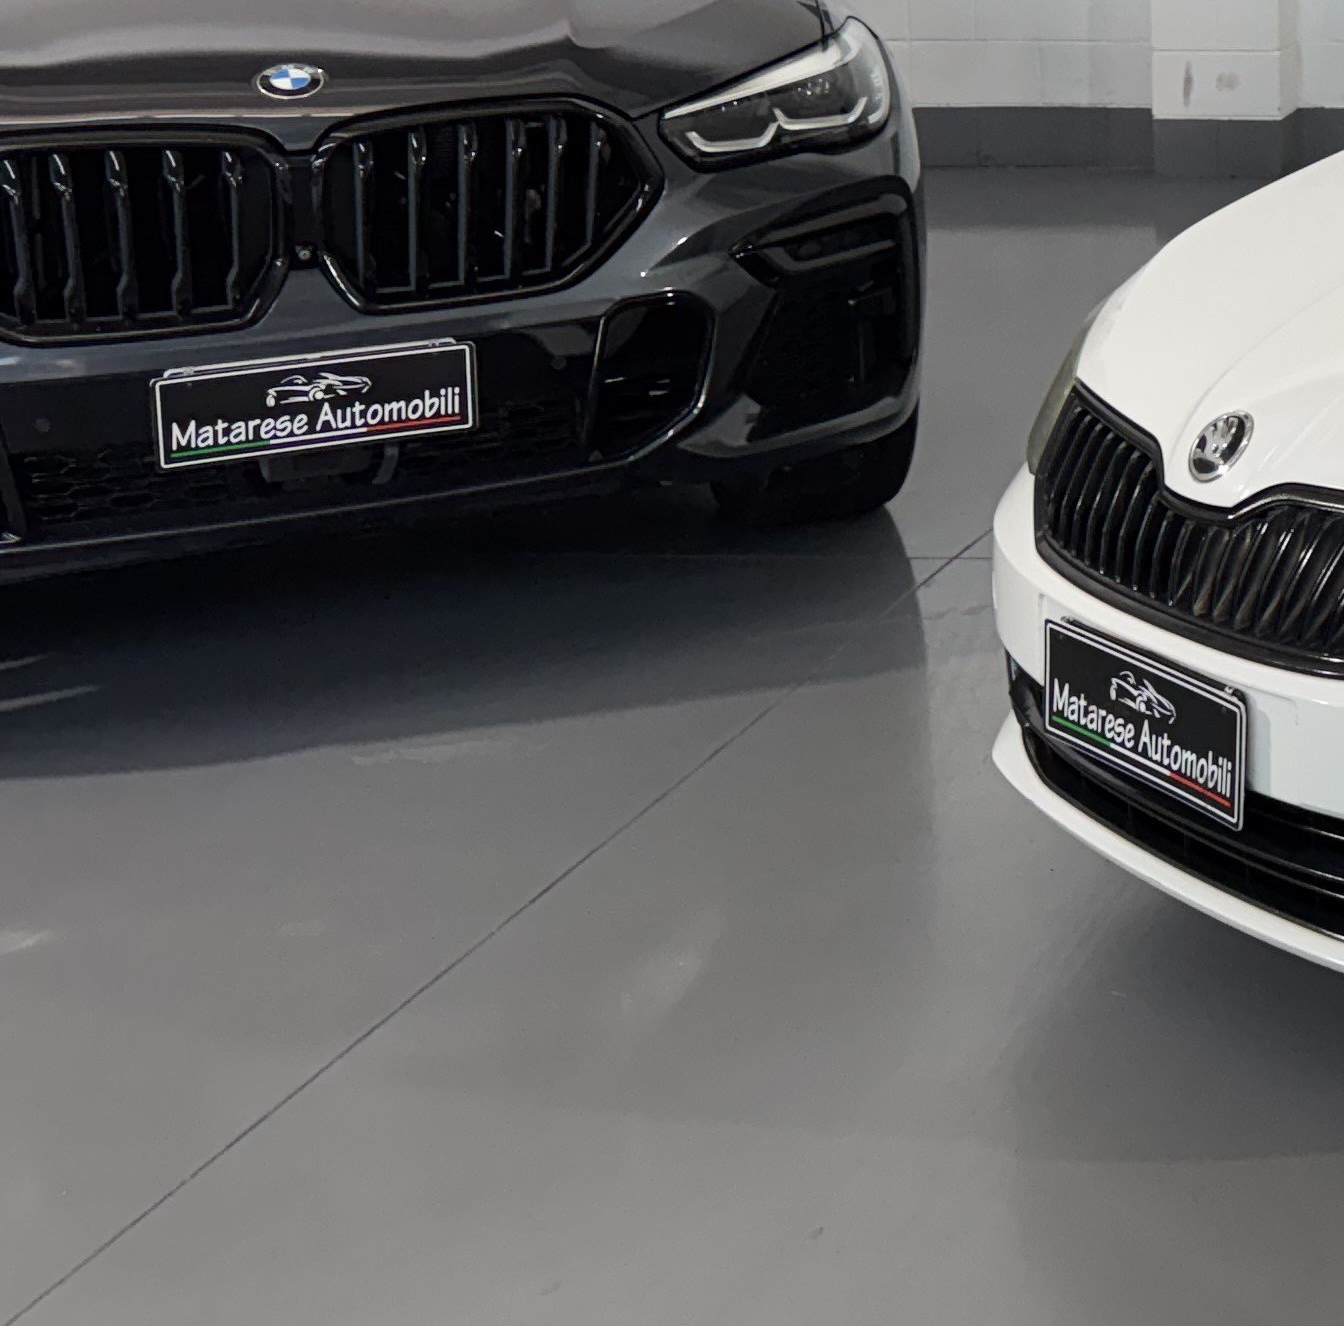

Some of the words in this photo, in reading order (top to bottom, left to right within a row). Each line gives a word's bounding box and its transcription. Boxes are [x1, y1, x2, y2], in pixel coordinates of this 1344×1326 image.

[171, 413, 309, 451] Matarese
[315, 386, 460, 432] Automobili
[1053, 677, 1135, 749] Matarese
[1138, 719, 1232, 798] Automobili
